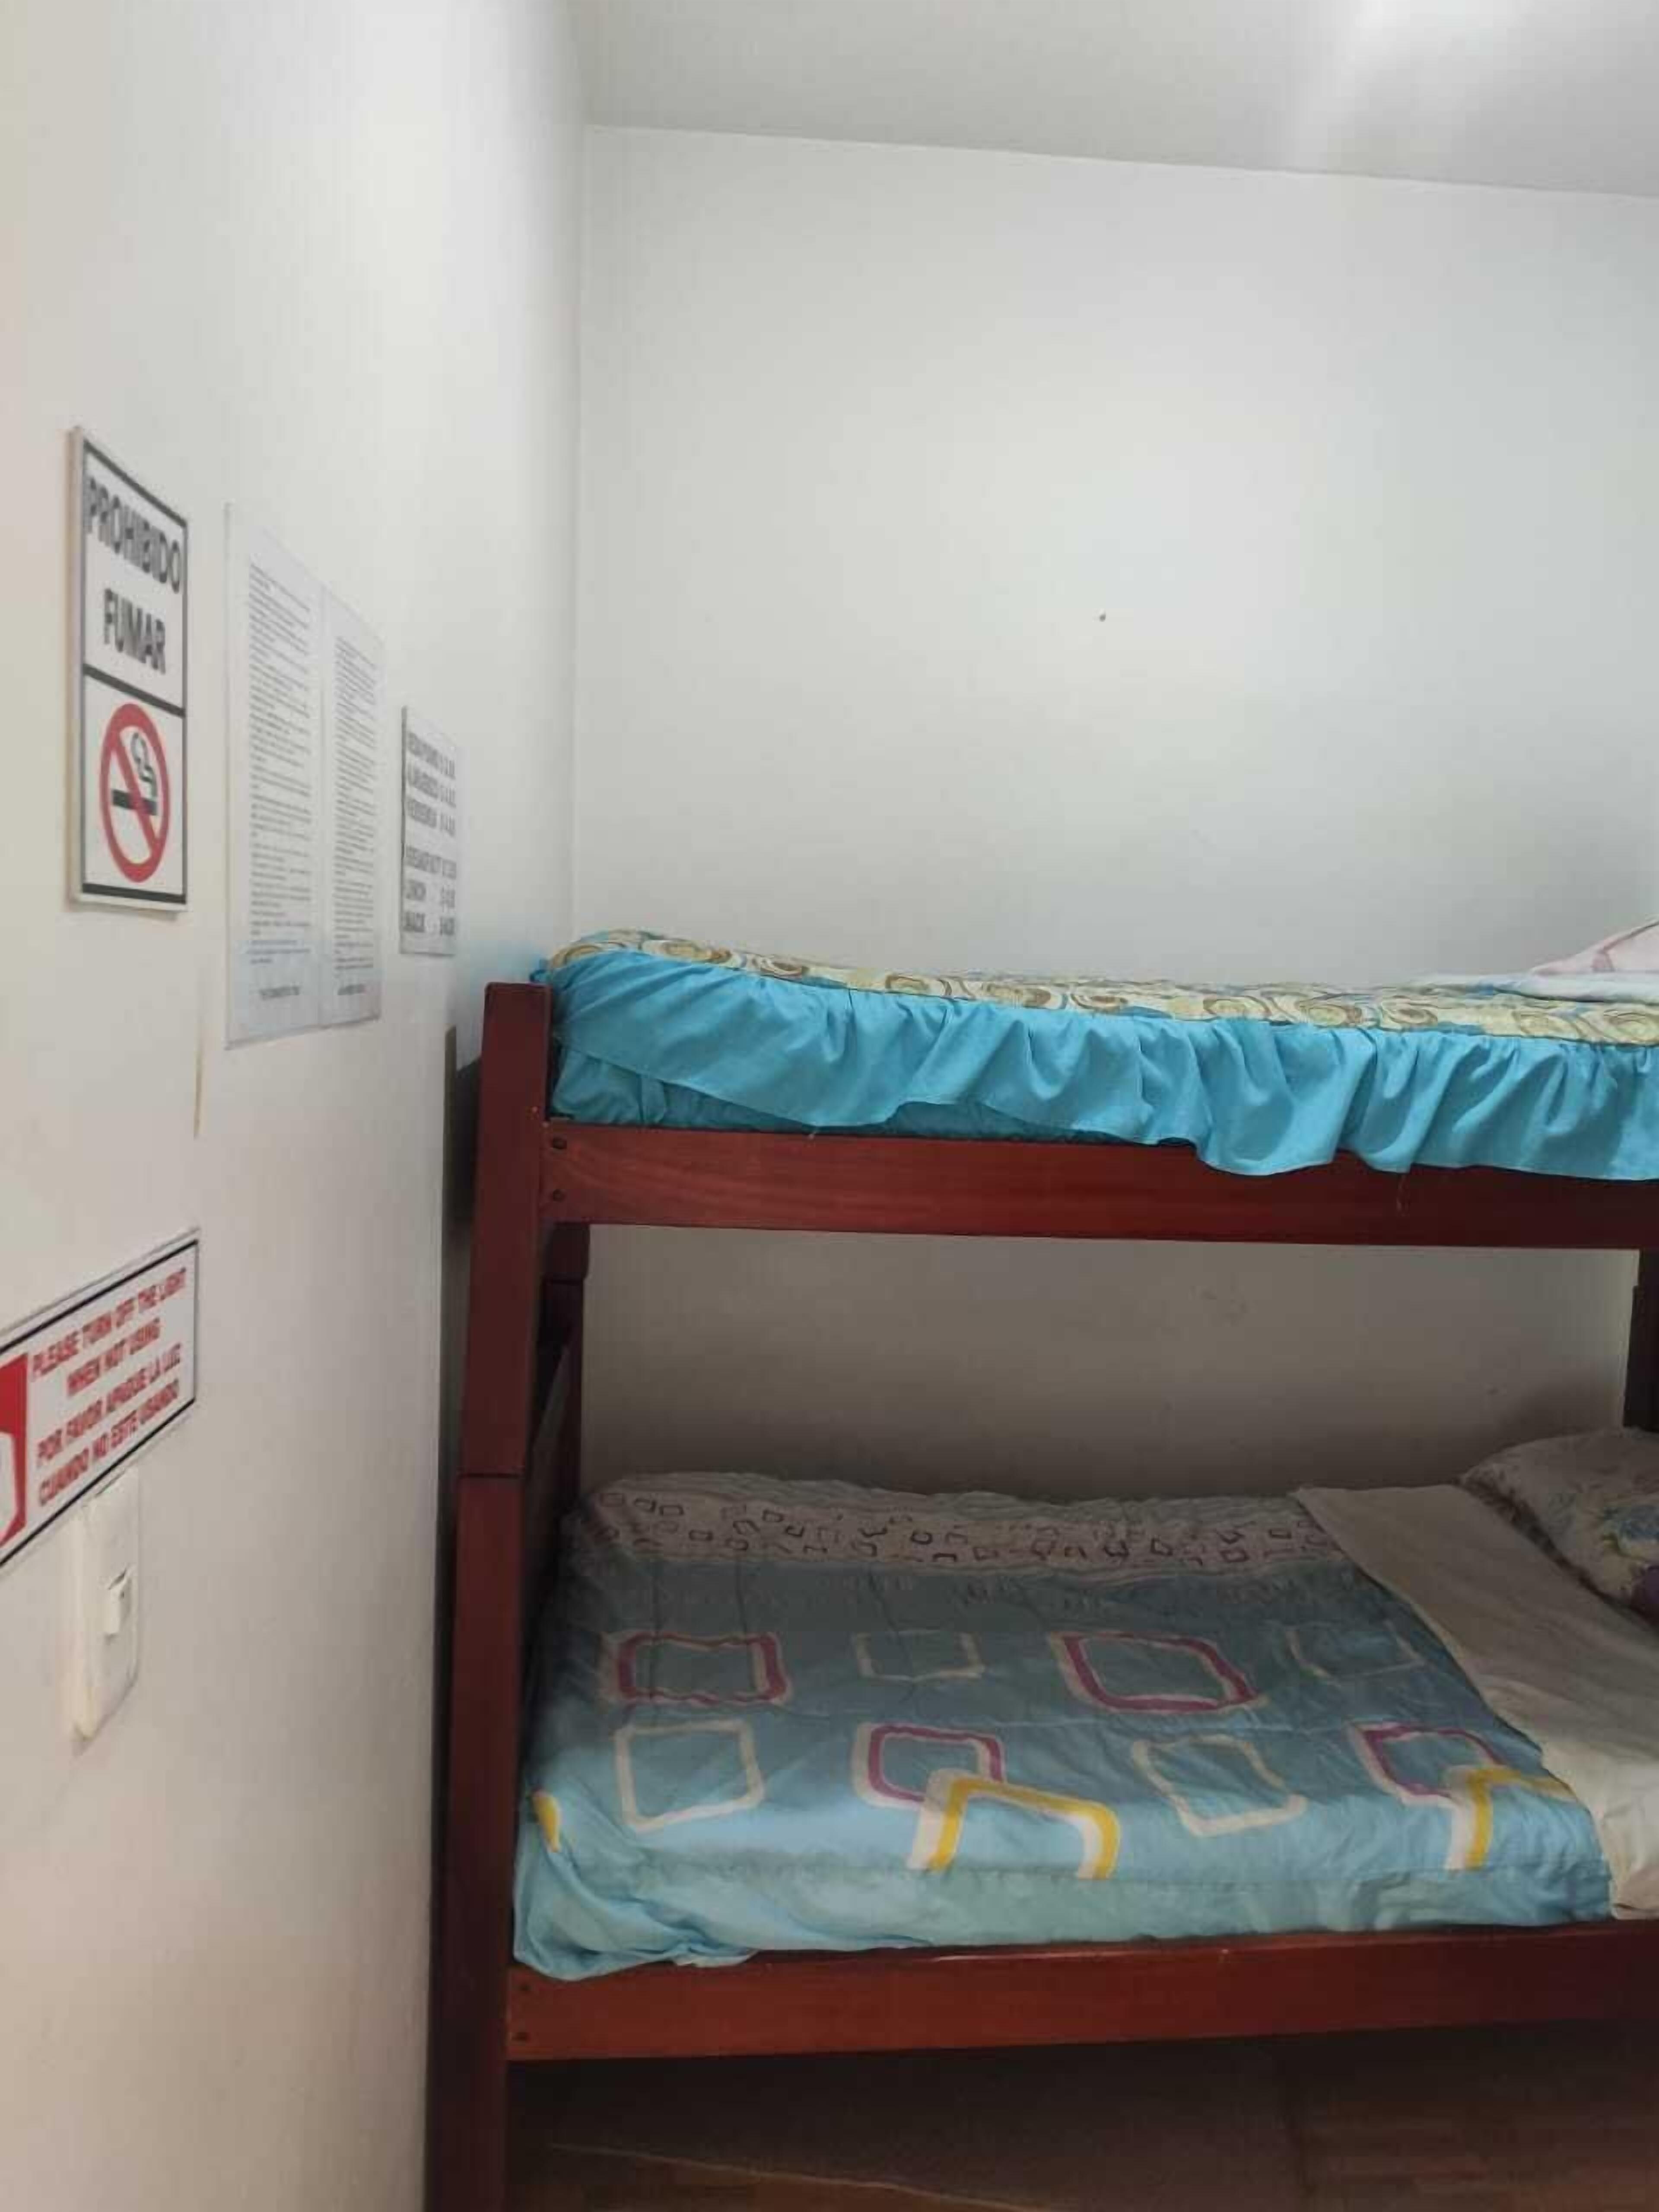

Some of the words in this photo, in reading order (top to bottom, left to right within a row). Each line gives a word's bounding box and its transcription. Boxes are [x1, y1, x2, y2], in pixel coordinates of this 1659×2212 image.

[87, 477, 181, 593] PROHIBIDO
[104, 589, 165, 674] FUMAR
[32, 1332, 79, 1379] PLEASE
[82, 1313, 112, 1347] TURN
[115, 1297, 135, 1328] OFF
[138, 1285, 157, 1312] THE
[158, 1268, 186, 1301] LIGHT
[67, 1356, 101, 1396] WHEN
[104, 1337, 127, 1371] NOT
[130, 1318, 160, 1354] USING
[36, 1427, 63, 1463] POR
[66, 1399, 103, 1444] FAVOR
[148, 1359, 161, 1384] LA
[162, 1343, 181, 1373] LUZ
[39, 1446, 89, 1506] CUANDO
[92, 1433, 108, 1463] NO
[139, 1379, 179, 1424] USANDO
